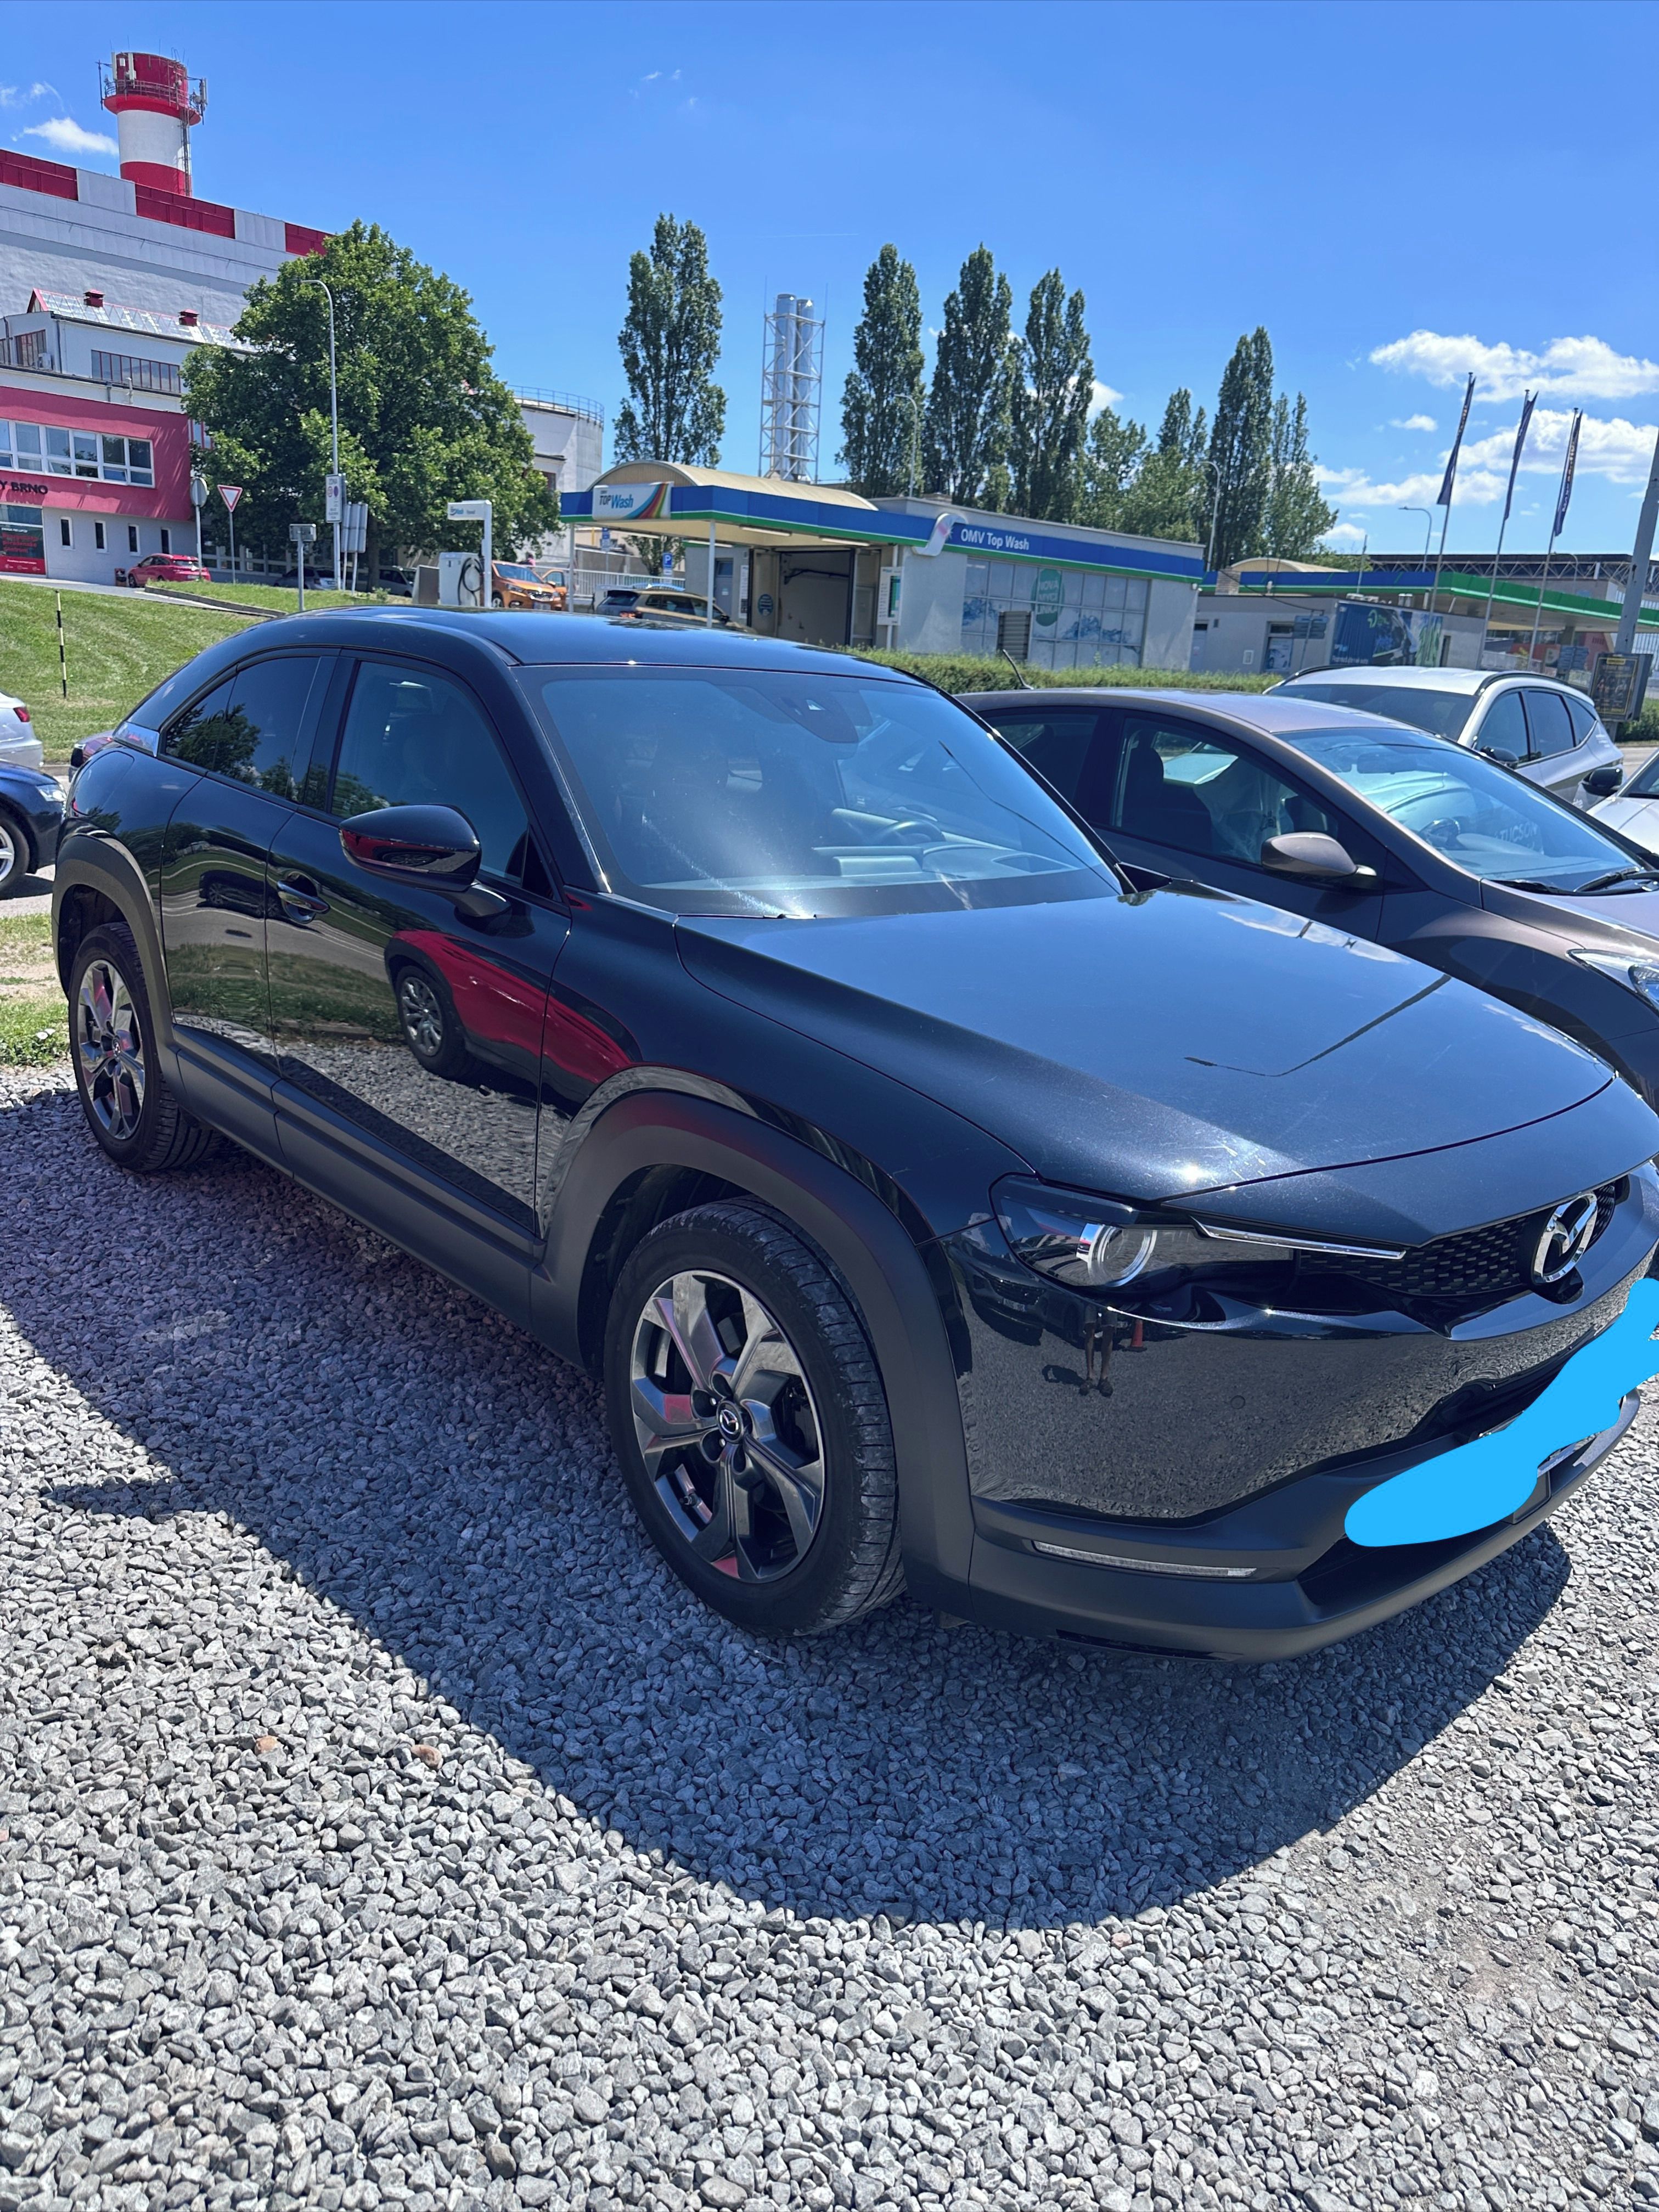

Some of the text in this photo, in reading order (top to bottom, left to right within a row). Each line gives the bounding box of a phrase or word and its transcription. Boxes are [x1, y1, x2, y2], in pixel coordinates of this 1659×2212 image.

[11, 482, 48, 494] BRNO
[599, 494, 633, 509] TOP Wash
[960, 528, 1030, 550] OMV Top Wash
